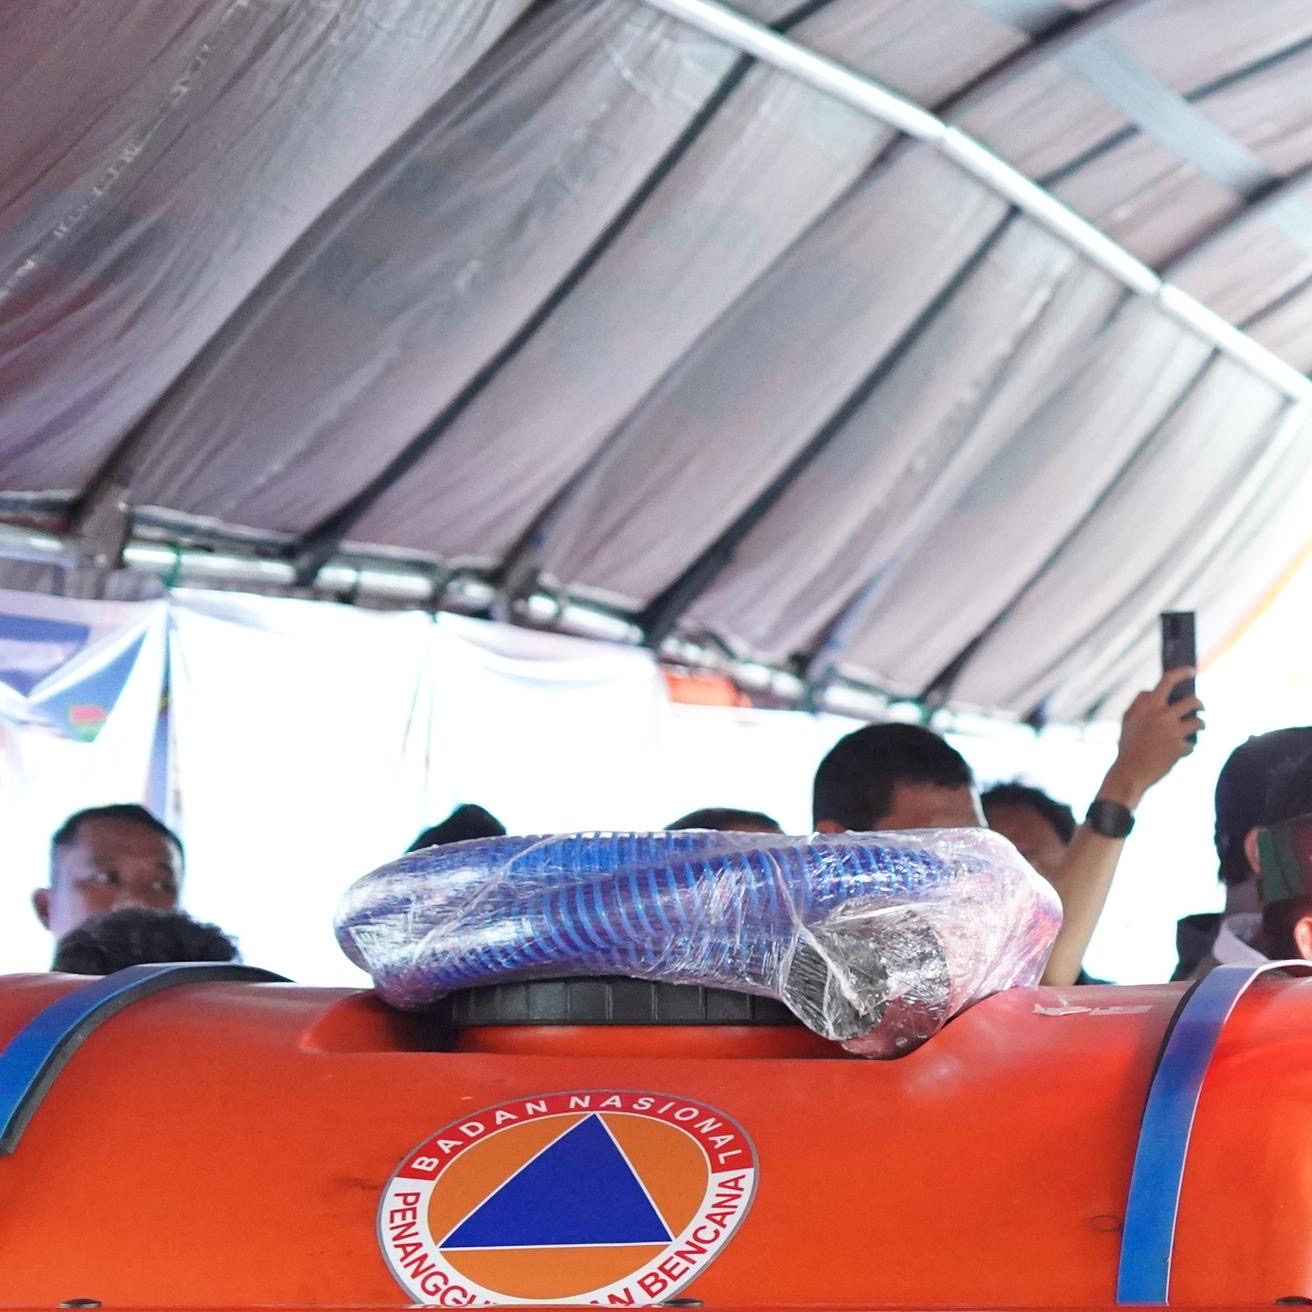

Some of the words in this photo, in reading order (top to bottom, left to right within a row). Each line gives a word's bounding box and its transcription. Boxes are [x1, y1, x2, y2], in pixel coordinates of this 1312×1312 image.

[412, 1101, 548, 1172] BADAN
[569, 1095, 743, 1165] NASIONAL
[638, 1174, 745, 1299] BENCANA
